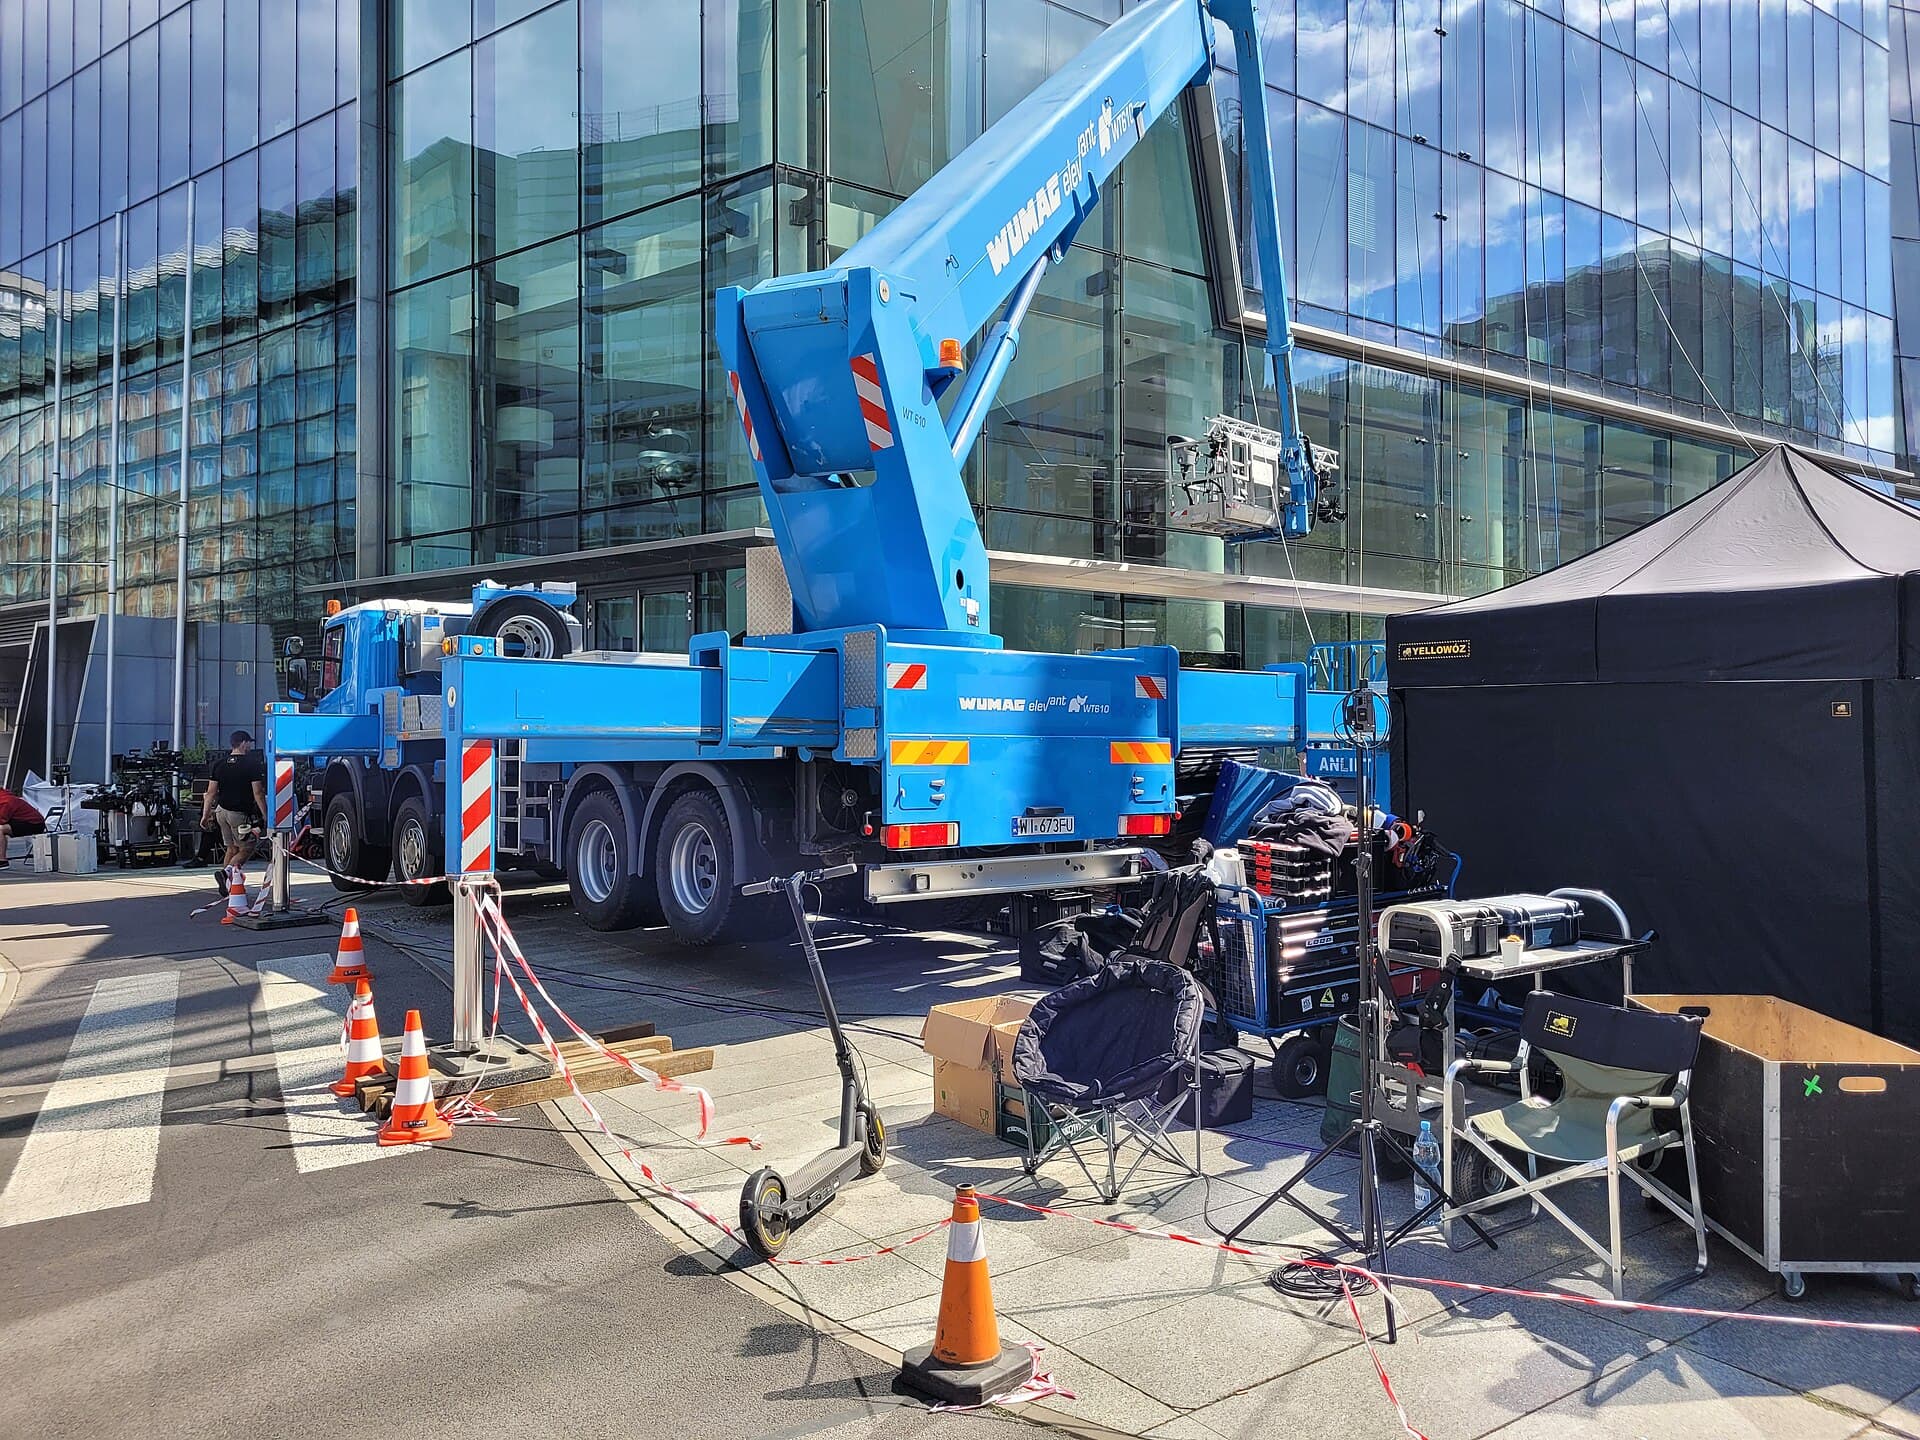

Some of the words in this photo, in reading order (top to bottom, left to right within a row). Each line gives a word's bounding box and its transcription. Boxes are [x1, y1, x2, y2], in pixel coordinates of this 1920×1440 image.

[986, 172, 1062, 276] WUMAG
[958, 697, 1026, 712] WUMAG
[1083, 704, 1110, 714] WT610
[1319, 756, 1372, 773] ANLIT
[1040, 818, 1073, 833] 673FU
